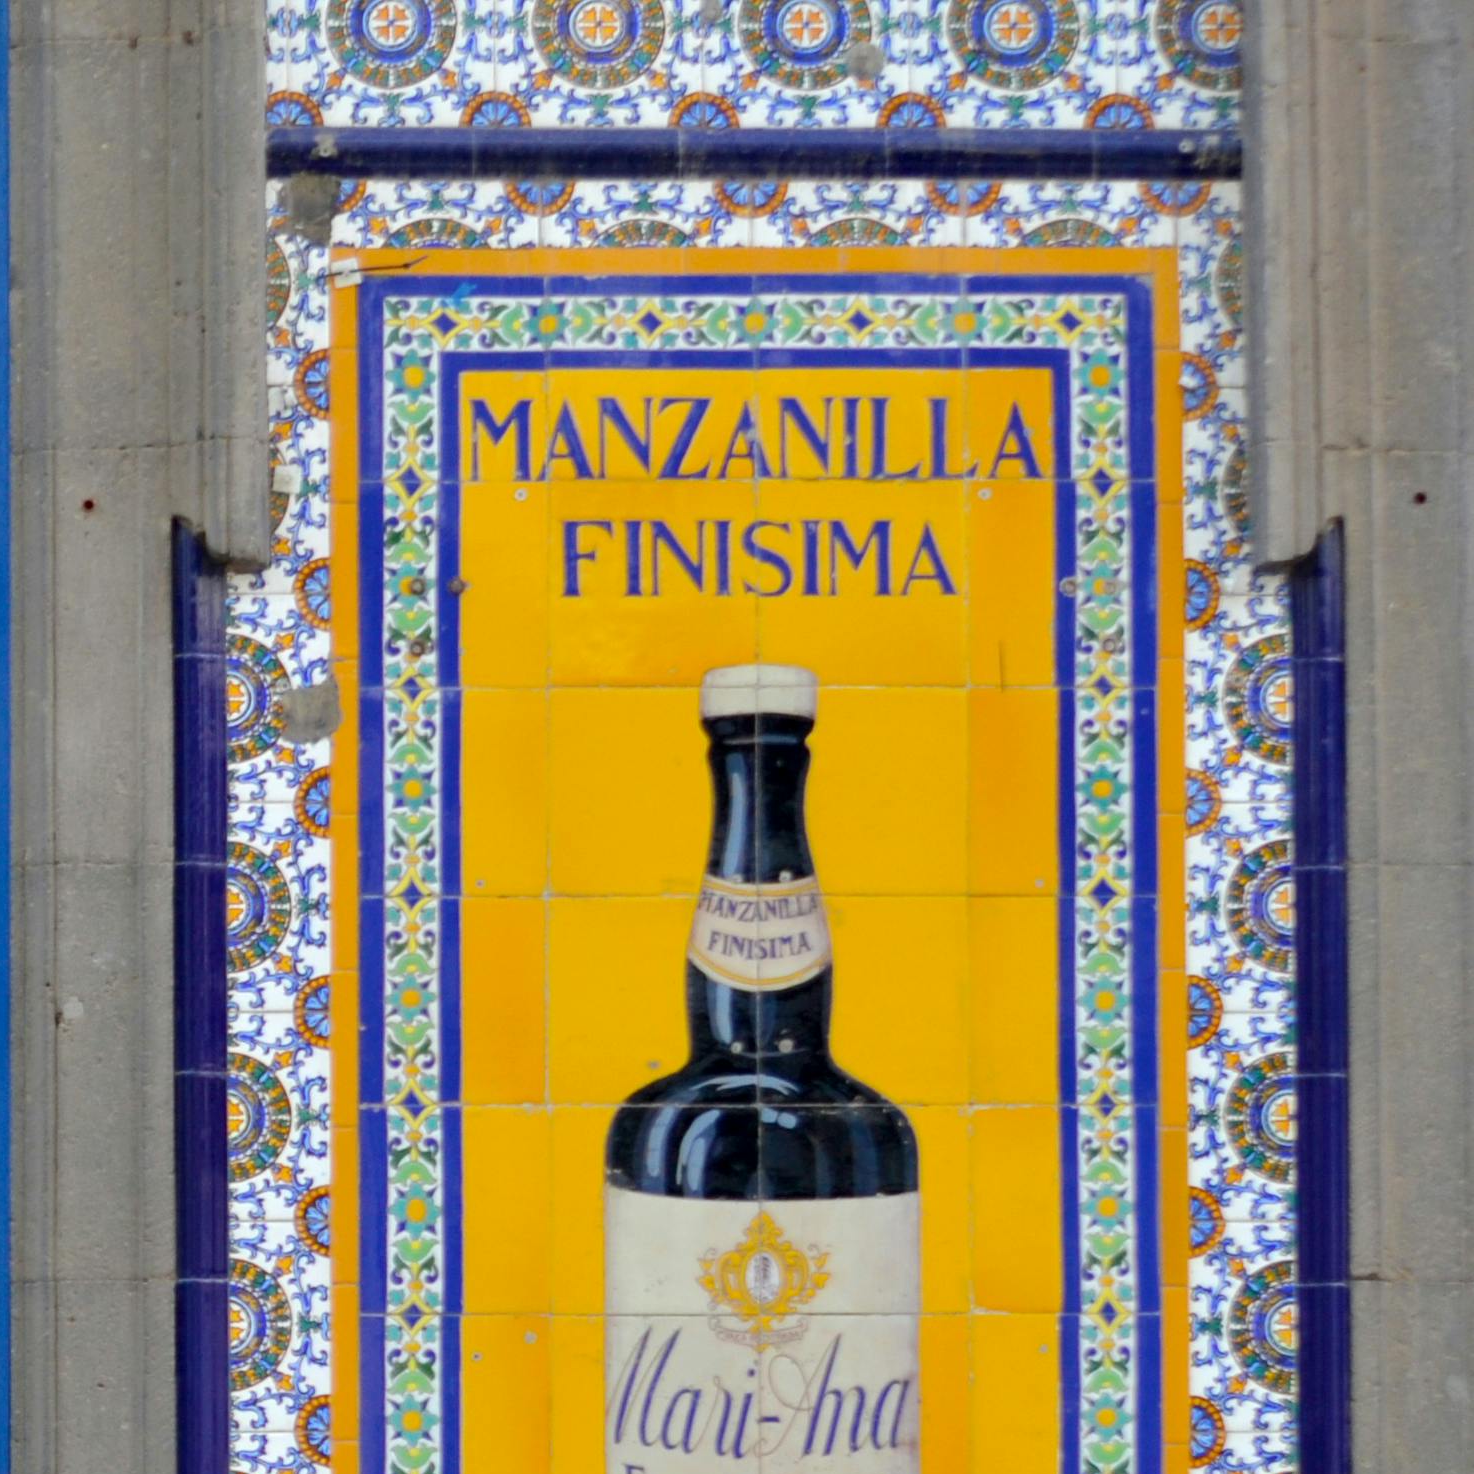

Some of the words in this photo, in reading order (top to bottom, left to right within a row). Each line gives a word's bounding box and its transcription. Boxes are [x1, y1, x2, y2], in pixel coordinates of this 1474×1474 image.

[470, 396, 1045, 483] MANZANILLA
[562, 519, 958, 598] FINISIMA
[697, 890, 818, 922] MANZANILLA
[708, 930, 811, 960] FINISIMA
